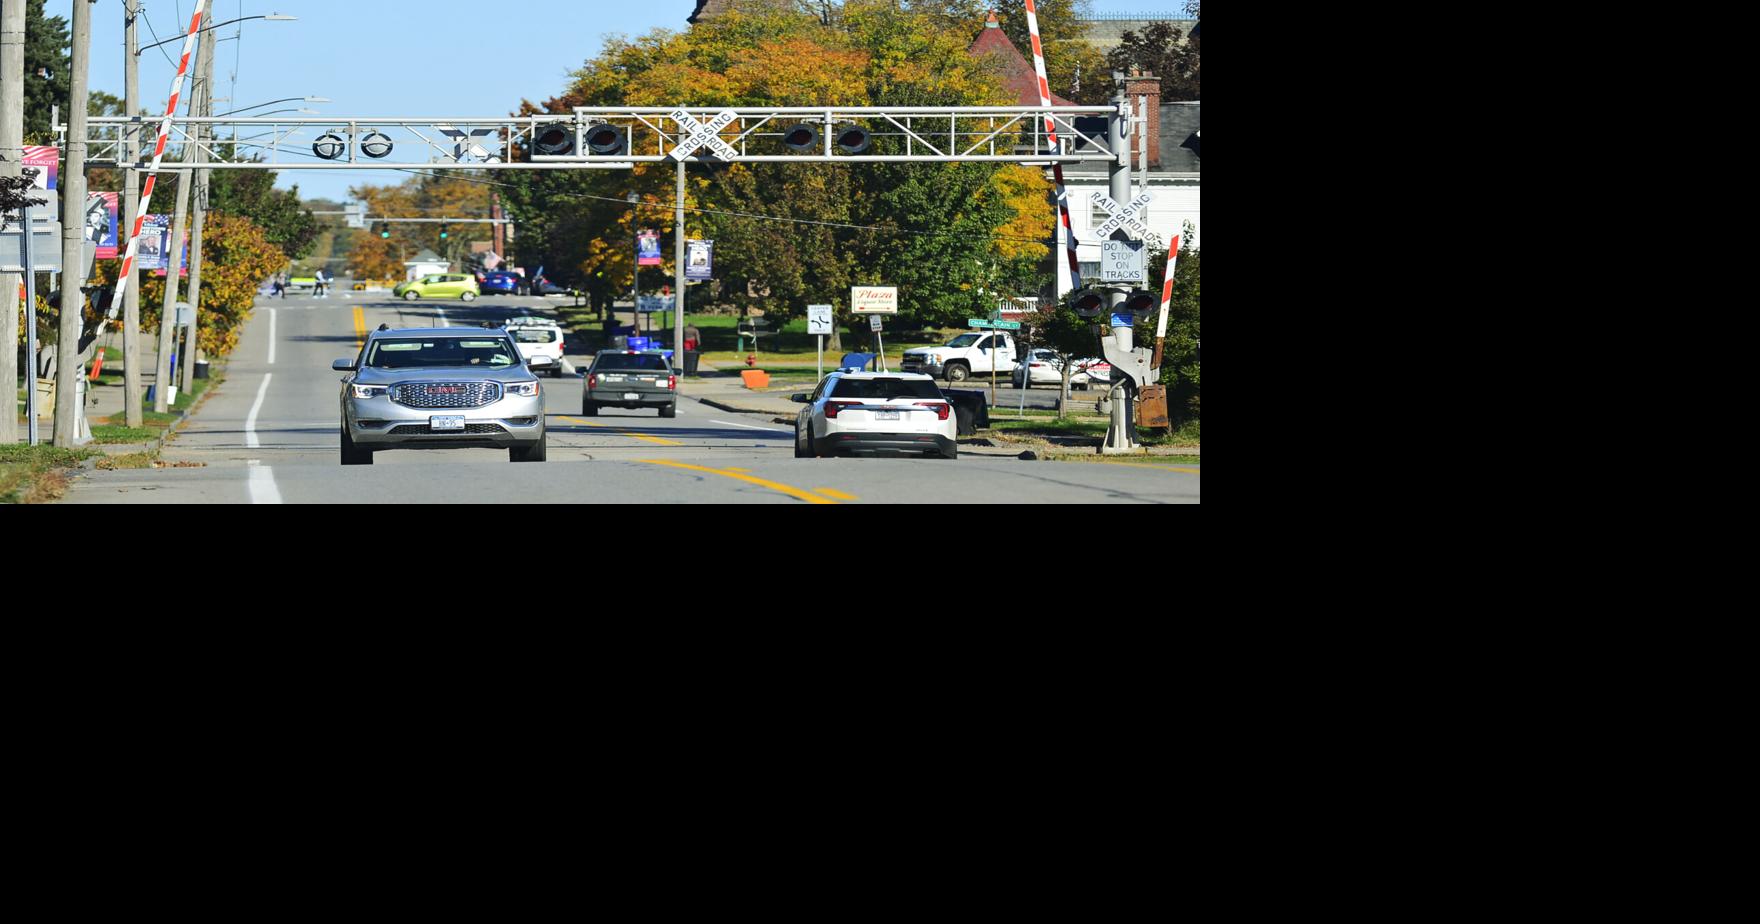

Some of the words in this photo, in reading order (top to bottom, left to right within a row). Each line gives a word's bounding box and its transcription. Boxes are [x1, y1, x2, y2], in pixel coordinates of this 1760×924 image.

[677, 113, 731, 156] CROSSING
[1096, 194, 1150, 238] CROSSING
[1110, 252, 1133, 260] STOP
[857, 290, 893, 298] Plaza
